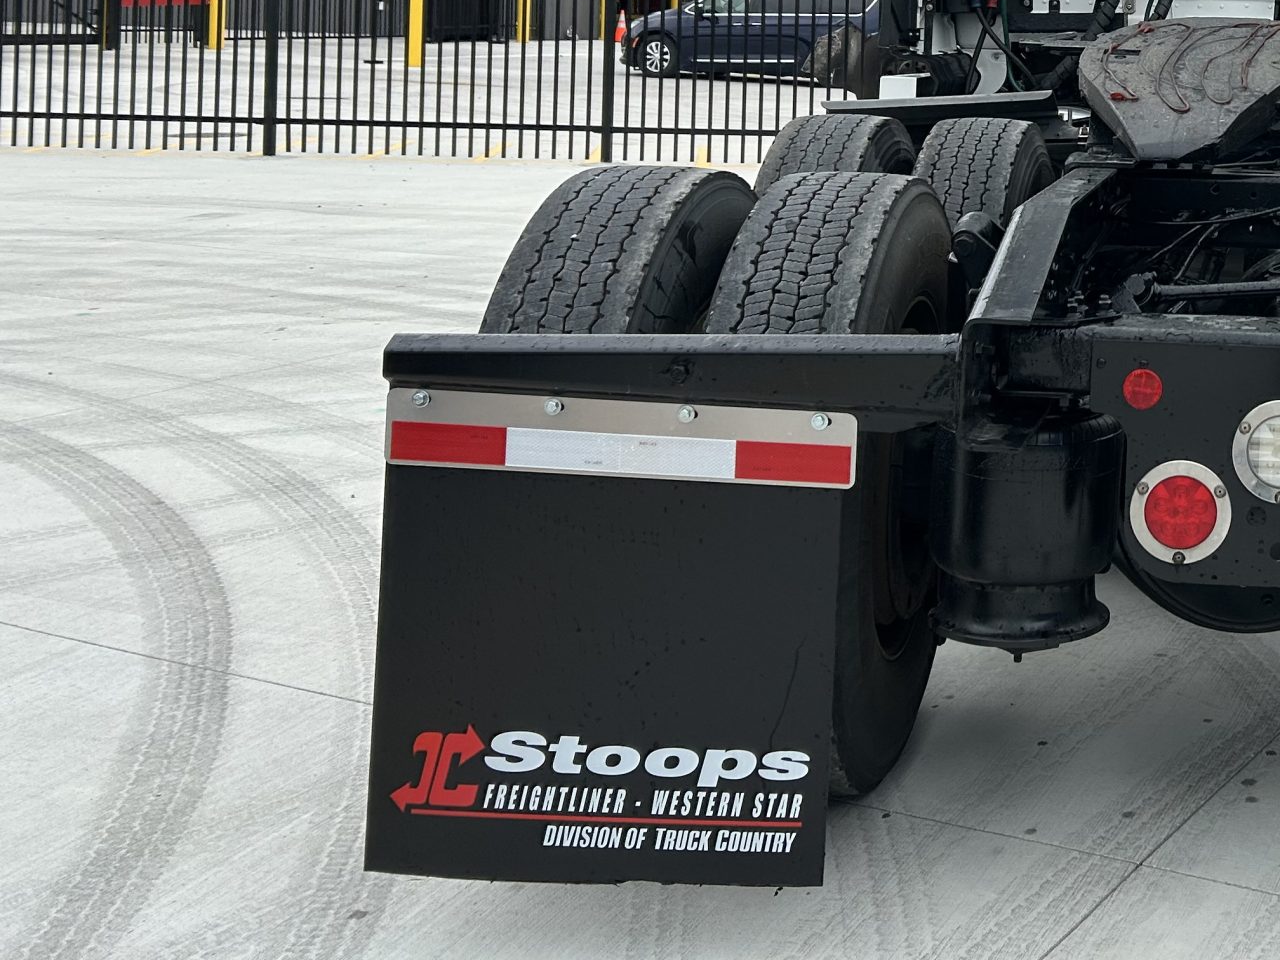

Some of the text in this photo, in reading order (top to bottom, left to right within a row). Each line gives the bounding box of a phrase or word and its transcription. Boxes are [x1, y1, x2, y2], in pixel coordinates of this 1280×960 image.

[484, 730, 811, 788] Stoops
[482, 783, 627, 814] FREIGHTLINER
[650, 789, 745, 818] WESTERN
[751, 792, 803, 819] STAR
[542, 824, 797, 853] DIVISION OF TRUCK COUNTRY
